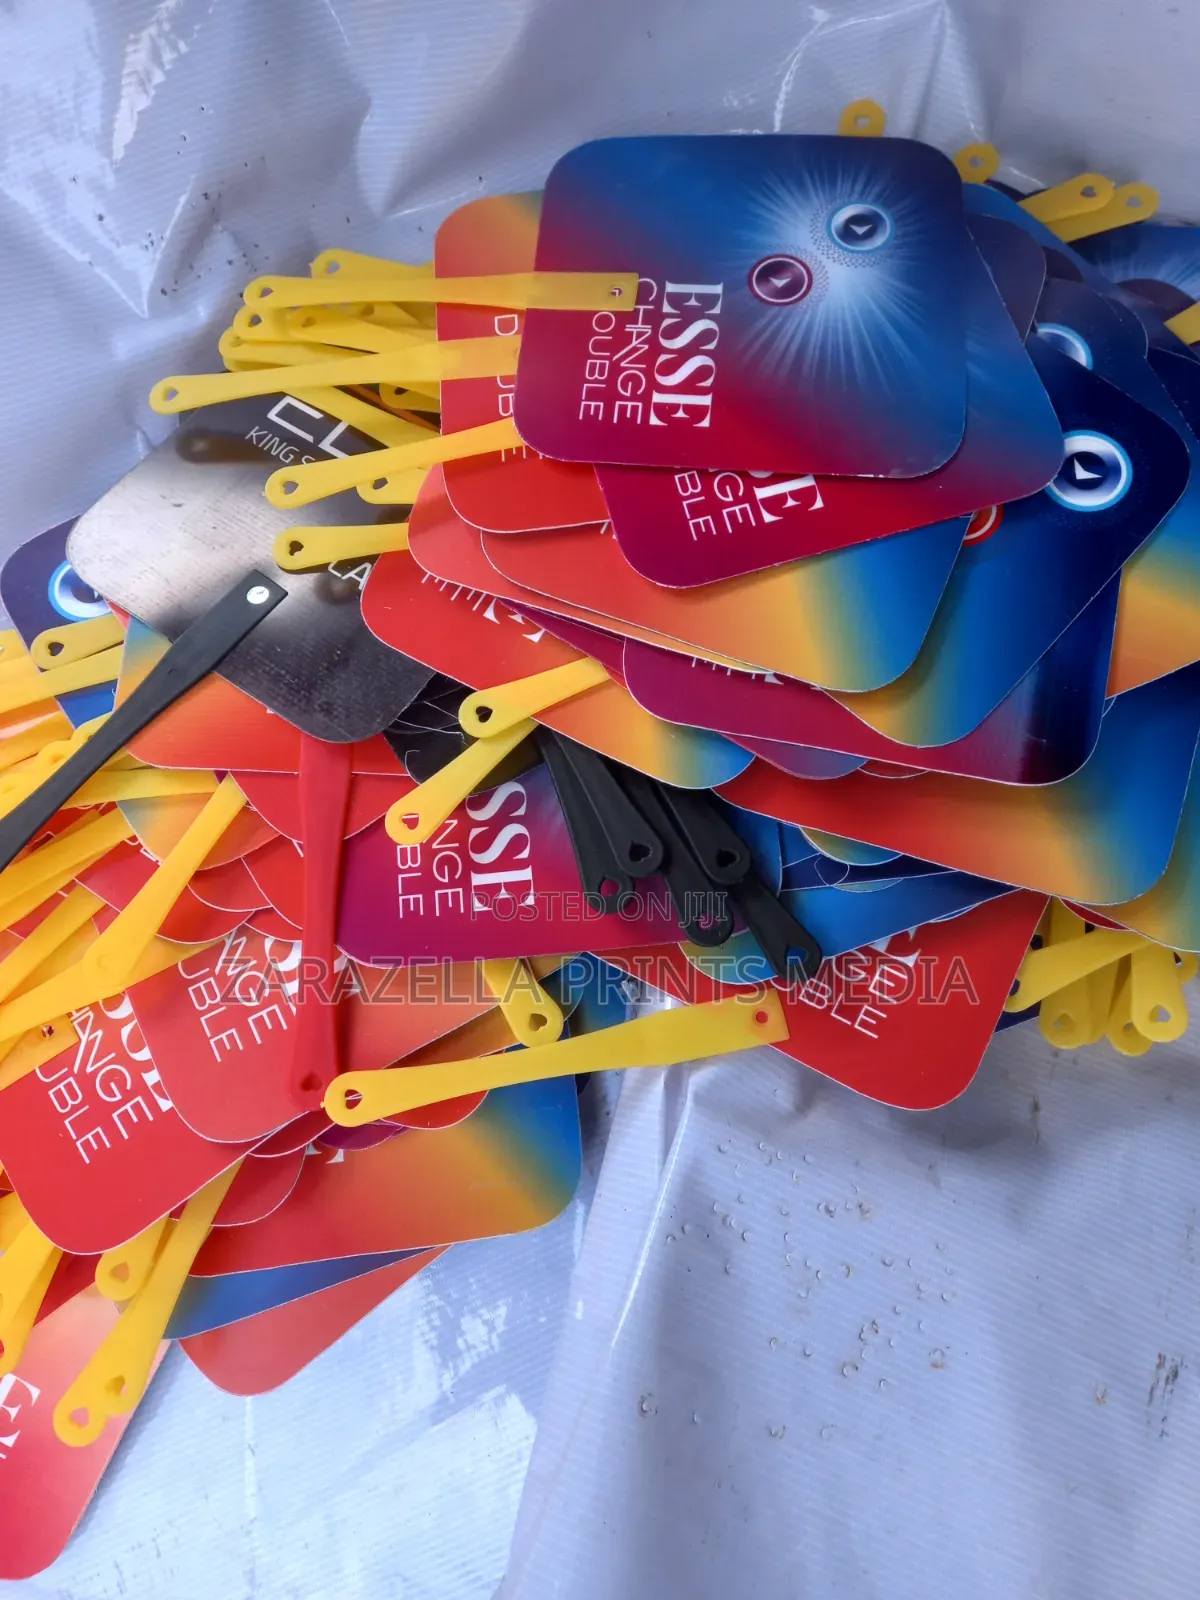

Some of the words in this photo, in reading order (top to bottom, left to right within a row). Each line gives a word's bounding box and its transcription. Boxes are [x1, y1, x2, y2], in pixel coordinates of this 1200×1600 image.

[579, 310, 616, 421] OUBLE
[613, 278, 658, 425] CHANGE
[649, 281, 724, 428] ESSE
[245, 425, 299, 464] KING
[674, 471, 717, 542] BLE
[396, 843, 424, 919] BLE
[431, 818, 465, 917] NGE
[464, 781, 536, 912] SSE
[177, 960, 244, 1063] UBLE
[214, 931, 289, 1045] NGE
[769, 976, 888, 1039] BLE
[35, 1067, 112, 1165] UBLE
